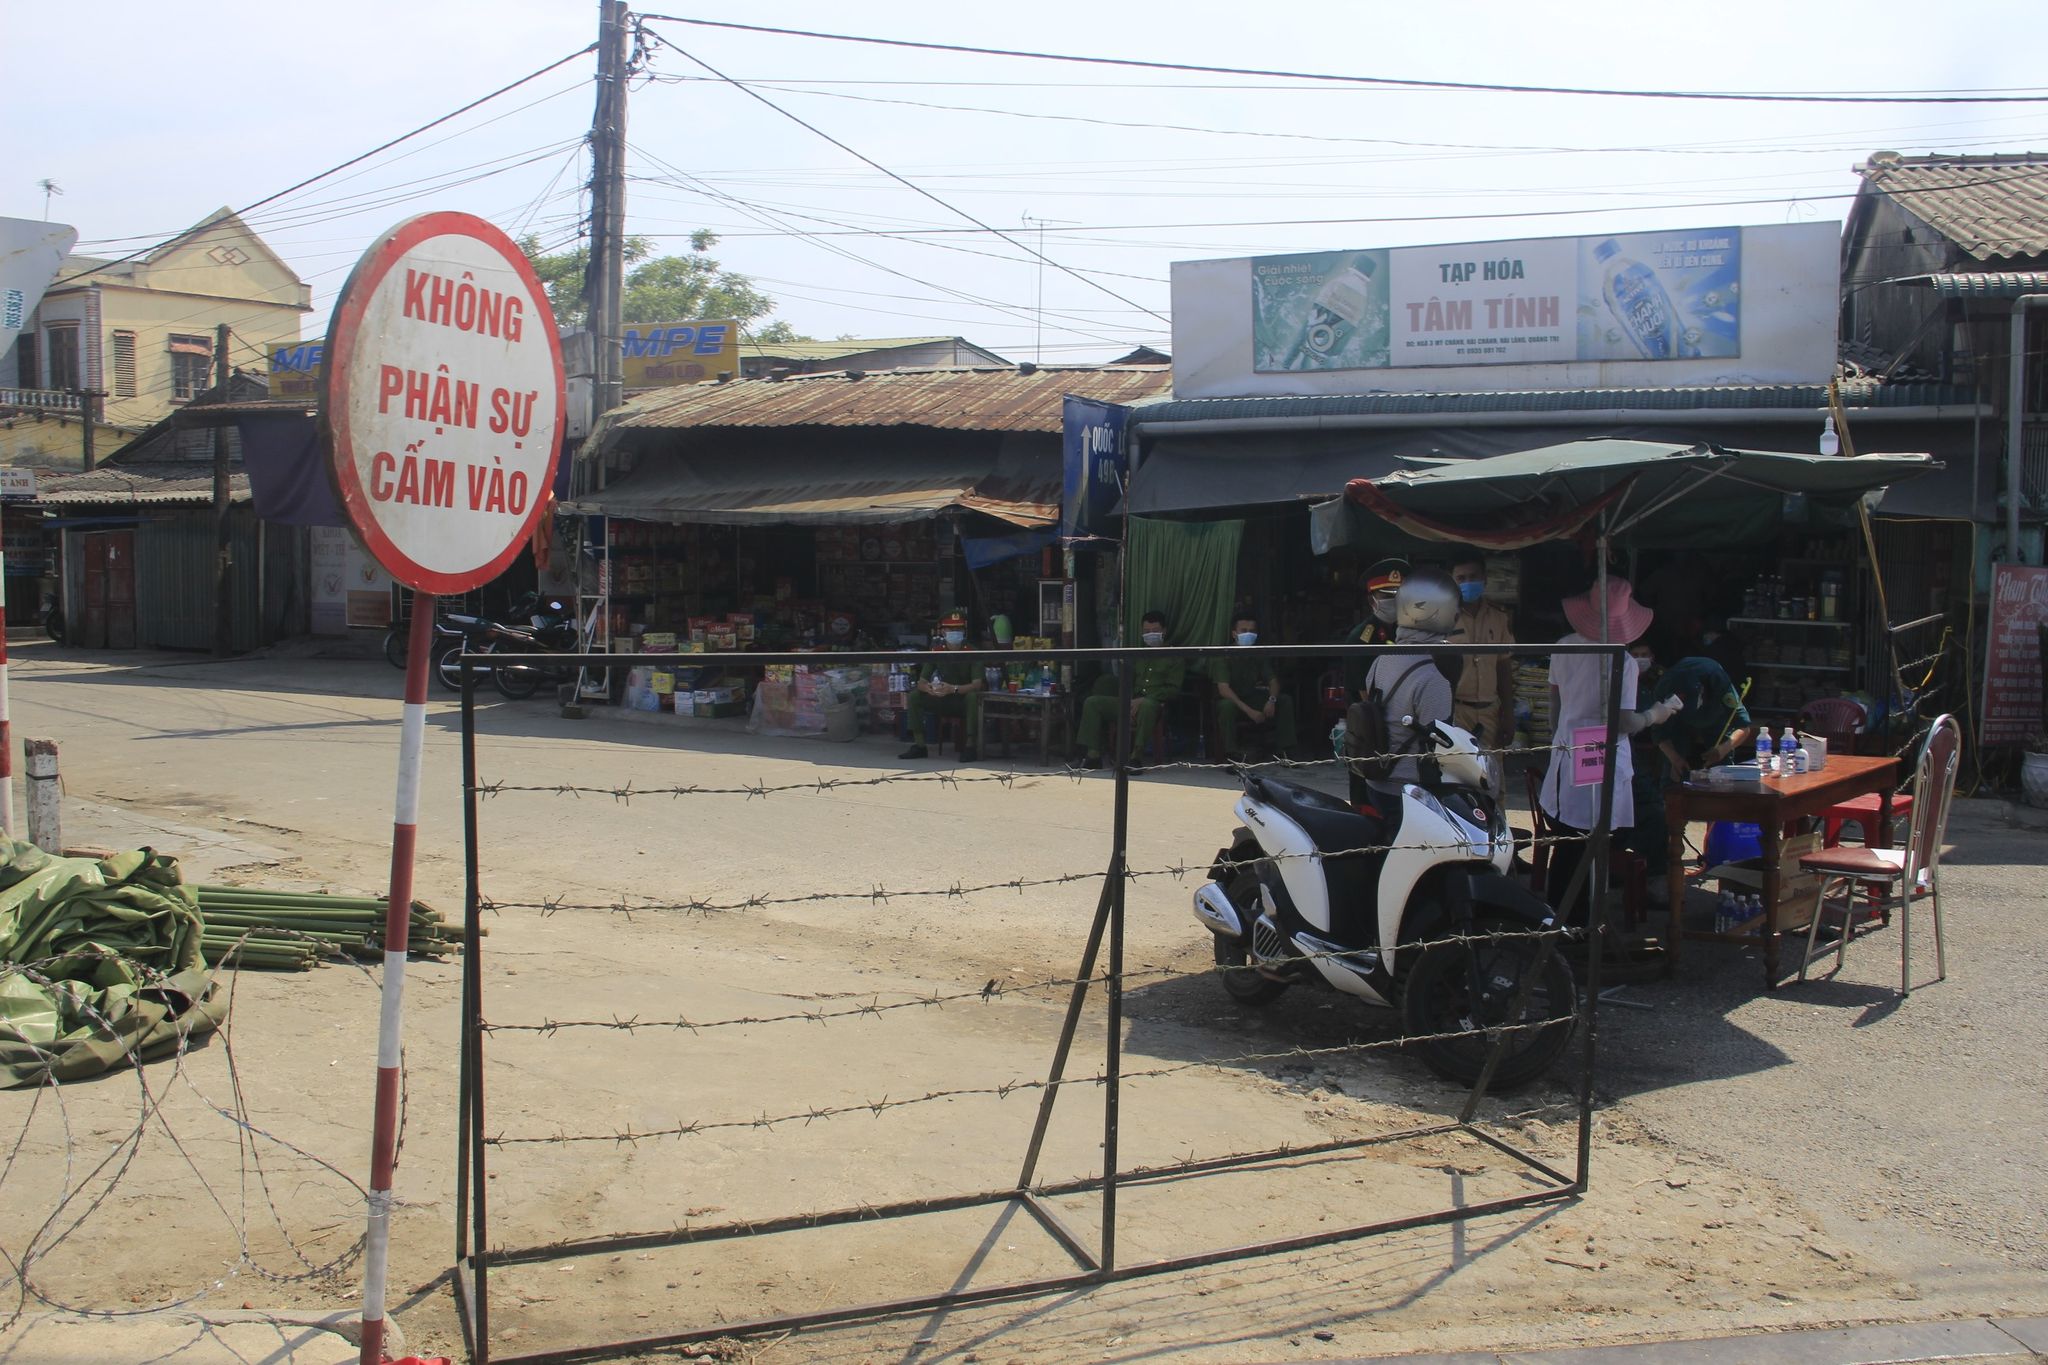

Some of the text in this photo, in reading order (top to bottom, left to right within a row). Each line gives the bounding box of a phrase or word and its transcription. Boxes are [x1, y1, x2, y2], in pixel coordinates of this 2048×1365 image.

[1439, 257, 1524, 286] TẠP HÓA
[403, 268, 524, 343] KHÔNG
[1406, 293, 1559, 332] TÂM TÍNH
[622, 325, 728, 358] MPE
[378, 363, 539, 449] PHẬN SỰ
[1092, 422, 1114, 455] QUỐC
[370, 440, 529, 516] CẤM VÀO
